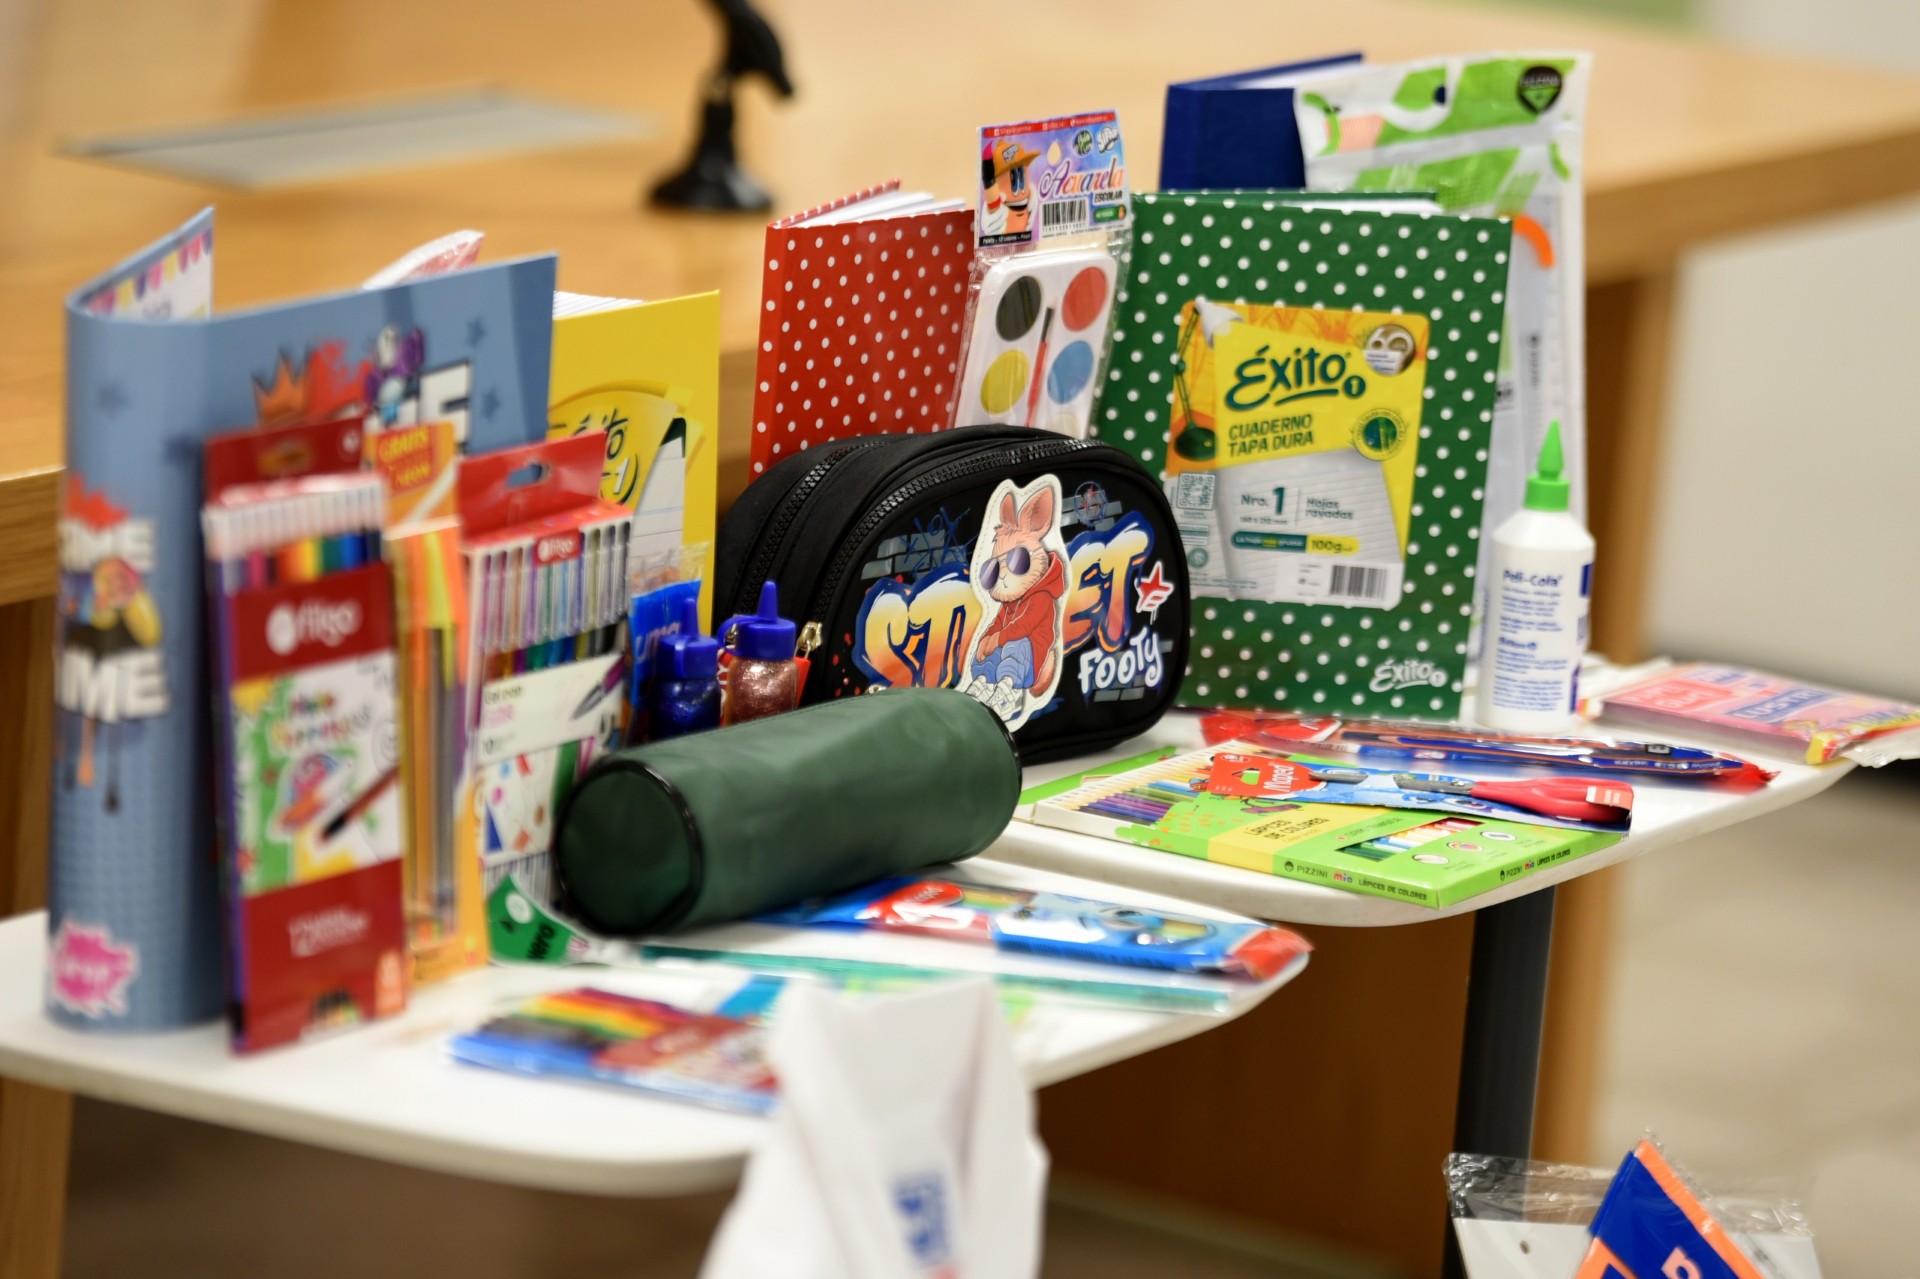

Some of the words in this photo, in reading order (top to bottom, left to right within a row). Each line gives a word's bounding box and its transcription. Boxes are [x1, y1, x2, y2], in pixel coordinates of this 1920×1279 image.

[1039, 157, 1125, 199] Acuarela
[1094, 190, 1123, 203] ESCOLAR
[1225, 344, 1347, 412] Éxito
[1228, 414, 1314, 440] CUADERNO
[1228, 436, 1269, 458] TAPA
[1272, 430, 1314, 451] DURA
[1241, 494, 1269, 508] Nro.
[1272, 486, 1286, 516] 1
[1368, 656, 1435, 693] Éxito
[1263, 763, 1296, 794] Maped
[1297, 865, 1328, 879] PIZZINI
[1358, 878, 1386, 891] LÁPICES
[1387, 885, 1397, 895] DE
[1398, 887, 1428, 901] COLORES
